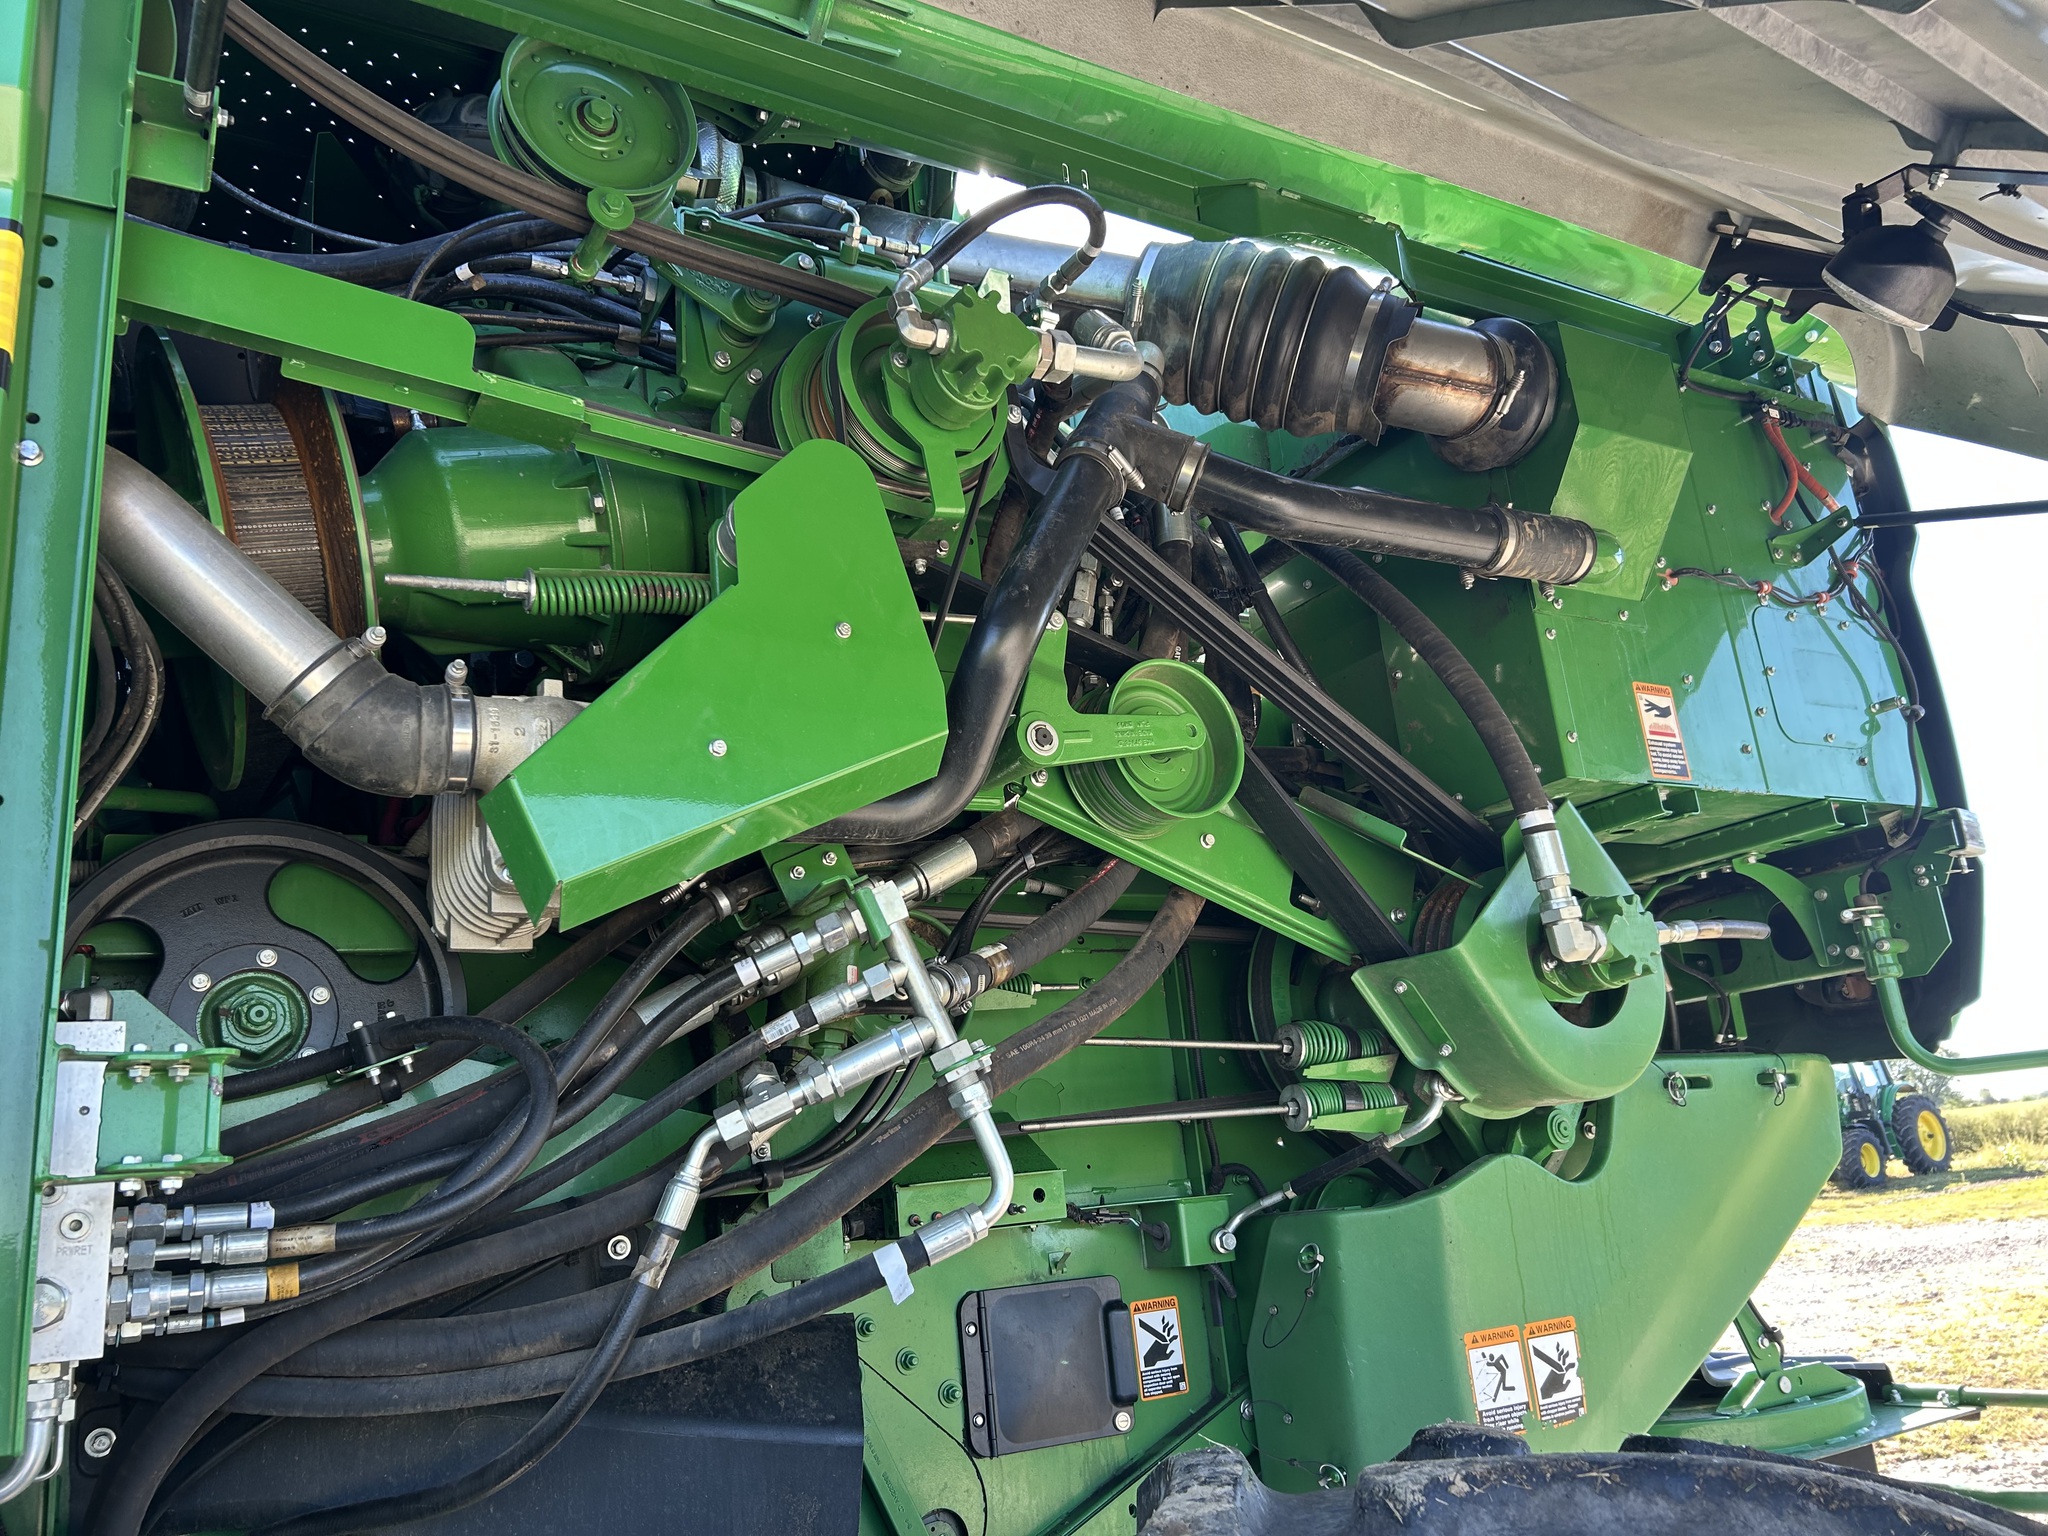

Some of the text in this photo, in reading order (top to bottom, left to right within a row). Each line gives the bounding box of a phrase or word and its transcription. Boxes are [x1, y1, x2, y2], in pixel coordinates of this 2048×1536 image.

[1640, 685, 1670, 695] WARNING
[1005, 1048, 1020, 1059] SAE
[1088, 1006, 1103, 1017] MADE
[1108, 997, 1118, 1007] USA
[1141, 1298, 1176, 1311] WARNING
[1535, 1319, 1572, 1334] WARNING
[1480, 1329, 1515, 1343] WARNING
